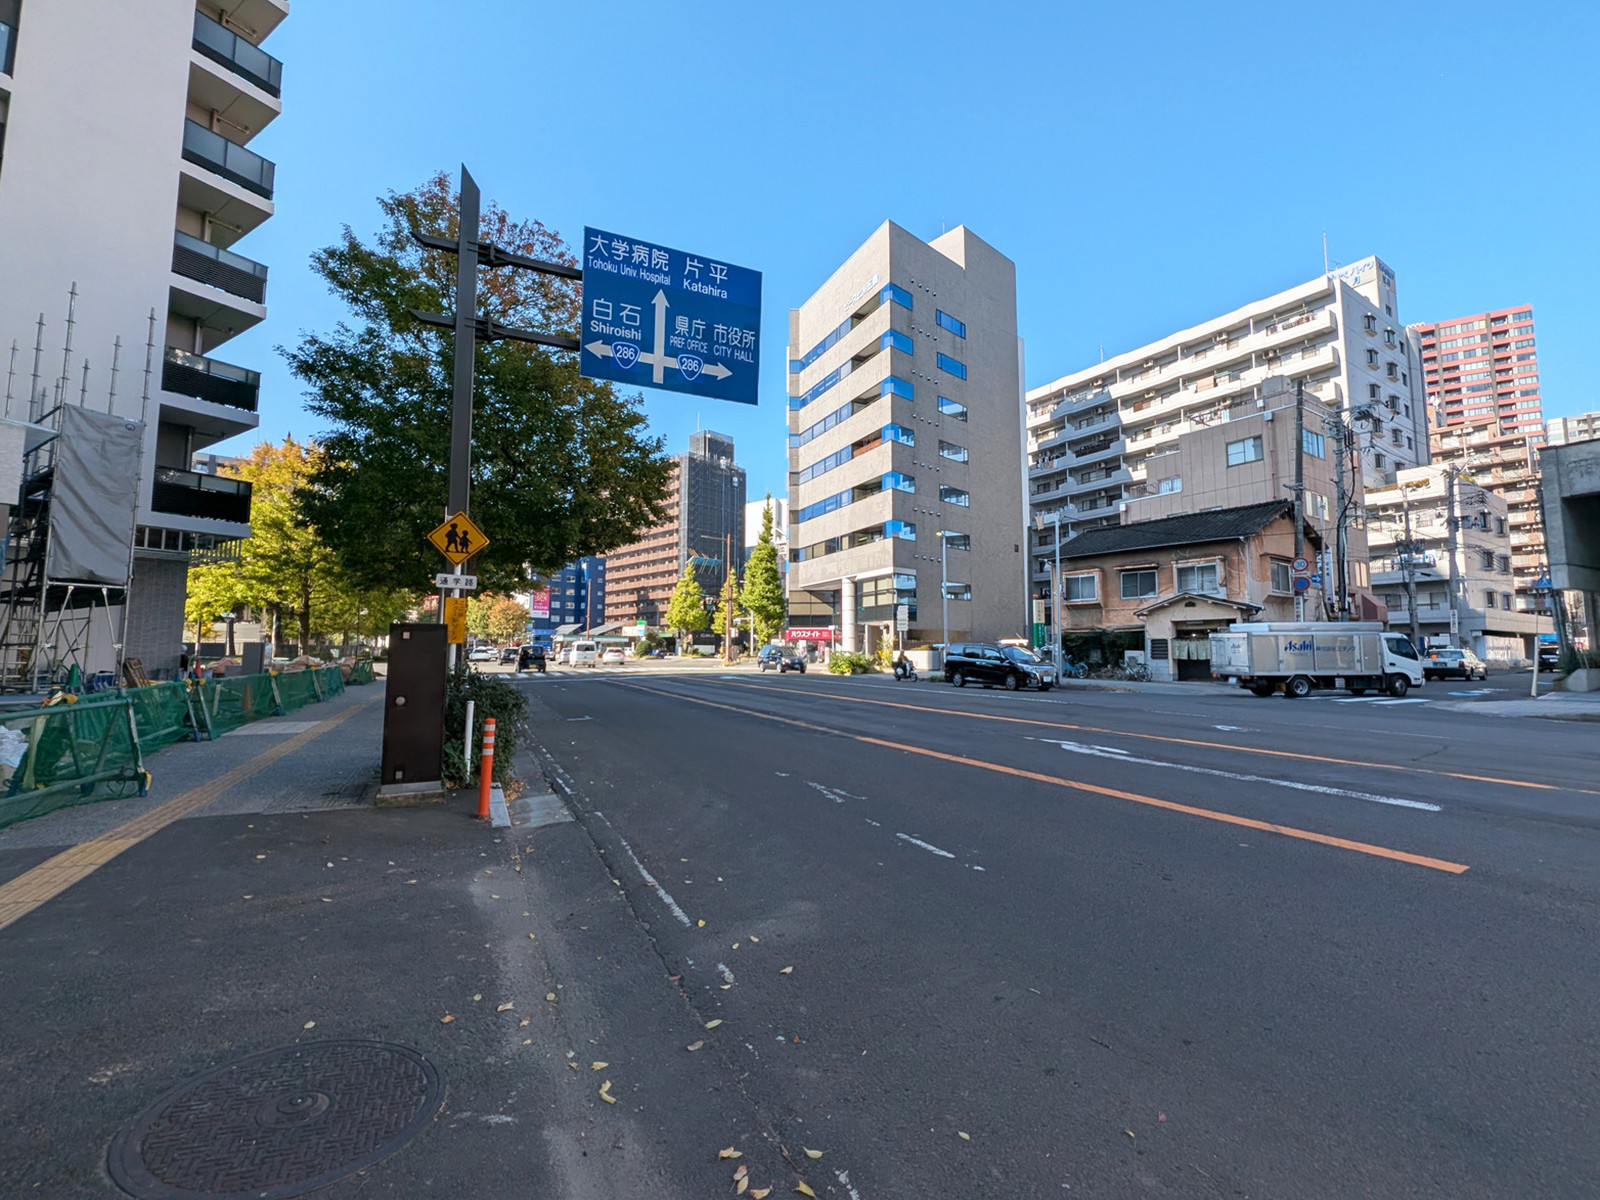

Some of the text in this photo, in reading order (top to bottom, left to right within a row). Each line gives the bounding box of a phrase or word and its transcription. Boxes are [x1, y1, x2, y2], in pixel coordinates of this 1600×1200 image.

[588, 235, 728, 284] 大学病院 片平
[588, 256, 728, 299] Tohoku Univ. Hospital Katahira
[593, 298, 641, 326] 白石
[590, 320, 642, 340] Shiroishi
[675, 315, 755, 350] 県庁 市役所
[616, 345, 636, 360] 286
[670, 335, 754, 363] PREF. OFFICE CITY HALL
[681, 358, 699, 371] 286
[1295, 560, 1306, 569] 30
[439, 576, 474, 587] 通学路
[791, 630, 821, 638] ハウスメイト
[1284, 640, 1313, 651] Asahi
